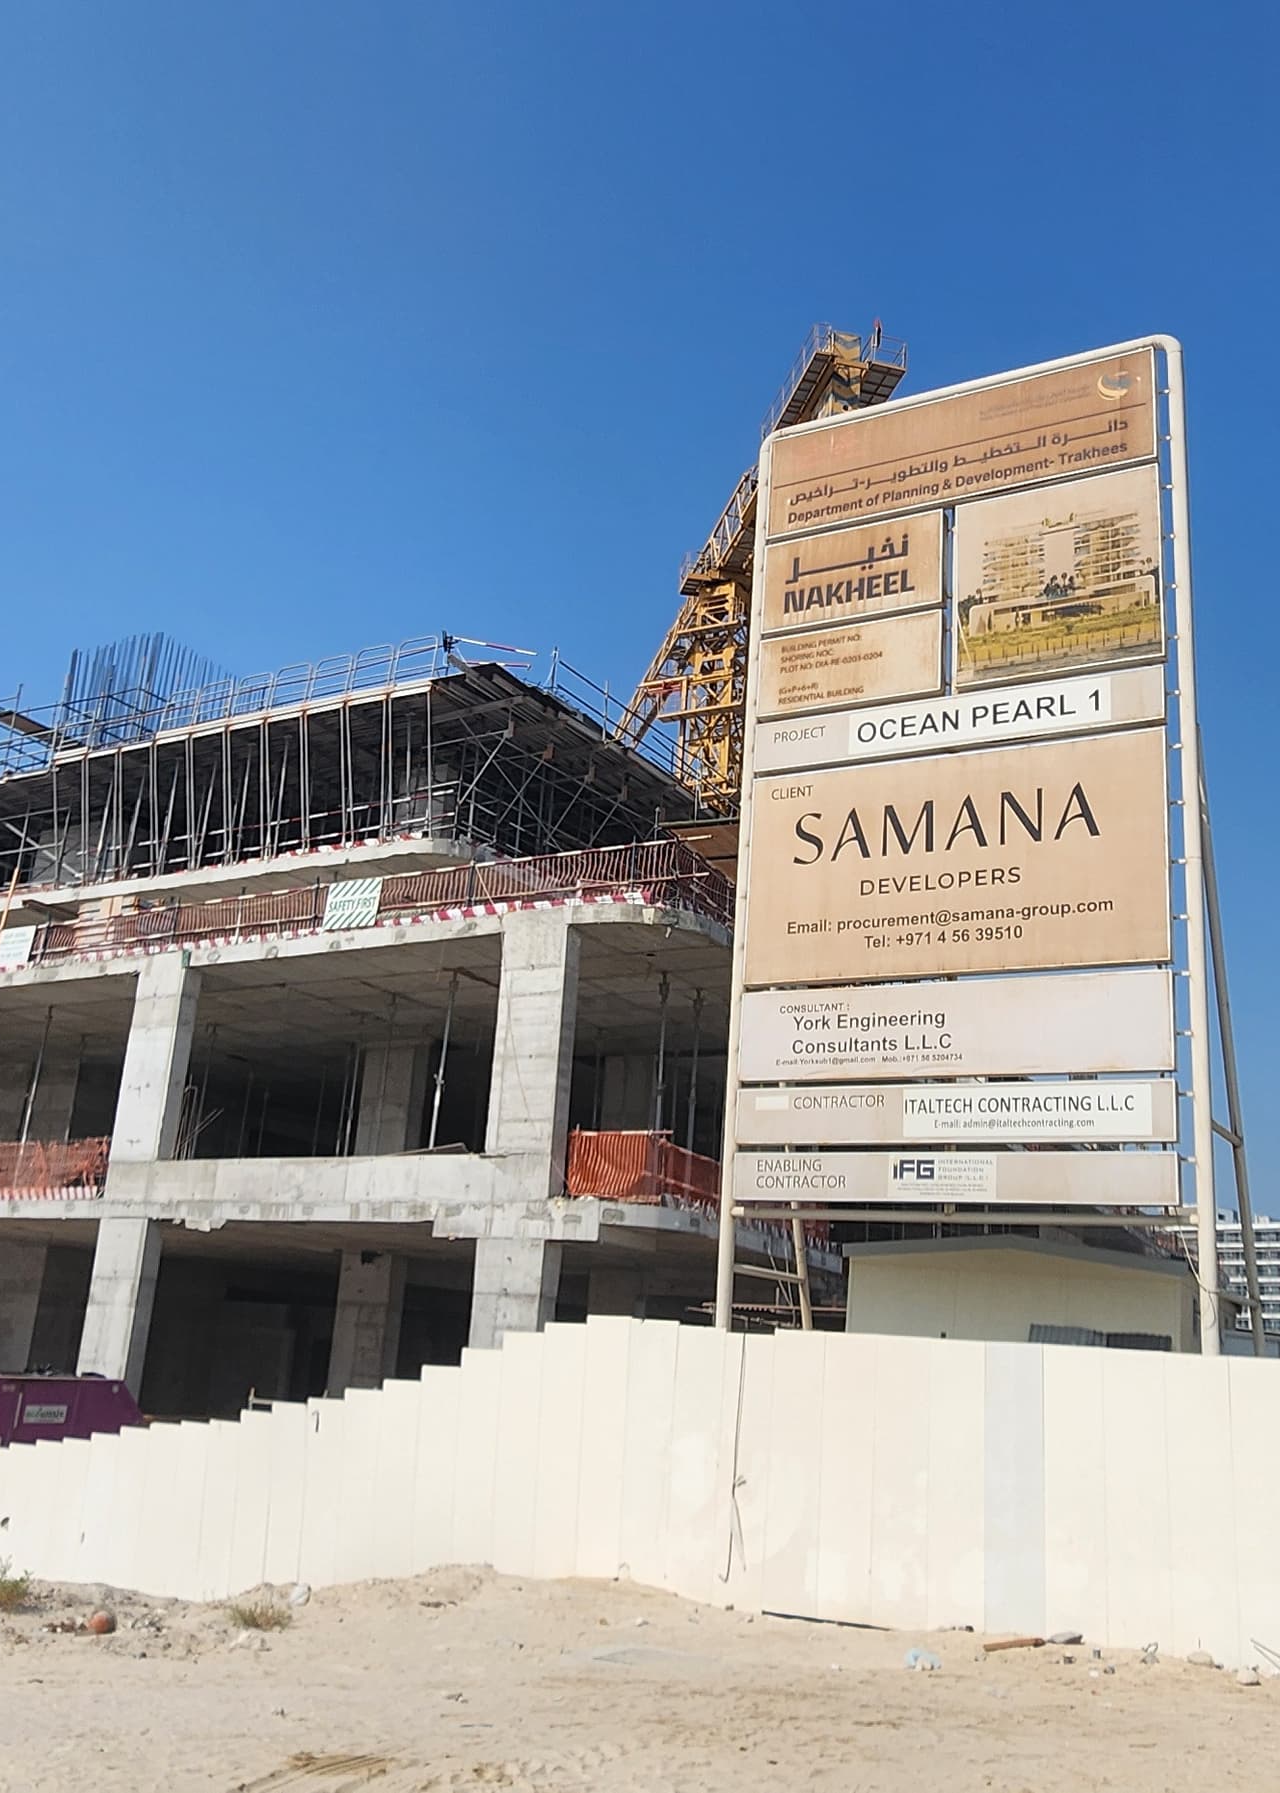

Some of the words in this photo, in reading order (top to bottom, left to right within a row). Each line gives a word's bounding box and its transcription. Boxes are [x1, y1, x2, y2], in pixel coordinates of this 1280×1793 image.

[788, 498, 863, 524] Department
[866, 494, 880, 507] of
[882, 482, 939, 504] Planning
[942, 478, 952, 490] &
[1058, 442, 1128, 466] Trakhees
[784, 569, 915, 614] NAKHEEL
[781, 641, 817, 654] BUILDING
[818, 635, 846, 648] PERMIT
[780, 664, 799, 675] PLOT
[778, 692, 824, 706] RESIDENTIAL
[826, 685, 864, 699] BUILDING
[857, 708, 960, 744] OCEAN
[971, 693, 1077, 729] PEARL
[1088, 688, 1101, 712] 1
[773, 725, 826, 744] PROJECT
[771, 784, 814, 801] CLIENT
[792, 781, 1101, 866] SAMANA
[859, 866, 1022, 897] DEVELOPERS
[328, 898, 356, 913] SAFETY
[786, 918, 833, 935] Email:
[837, 898, 1114, 935] procurement@samana-group.com
[864, 933, 891, 950] Tel:
[895, 930, 932, 947] +971
[937, 930, 947, 945] 4
[951, 928, 970, 944] 56
[974, 924, 1024, 942] 39510
[792, 1014, 831, 1032] York
[836, 1010, 946, 1033] Engineering
[792, 1037, 898, 1055] Consultants
[904, 1033, 952, 1051] L.L.C
[793, 1095, 885, 1110] CONTRACTOR
[904, 1097, 972, 1115] ITALTECH
[977, 1095, 1092, 1113] CONTRACTING
[1096, 1094, 1135, 1112] L.L.C
[756, 1159, 822, 1173] ENABLING
[756, 1175, 847, 1189] CONTRACTOR
